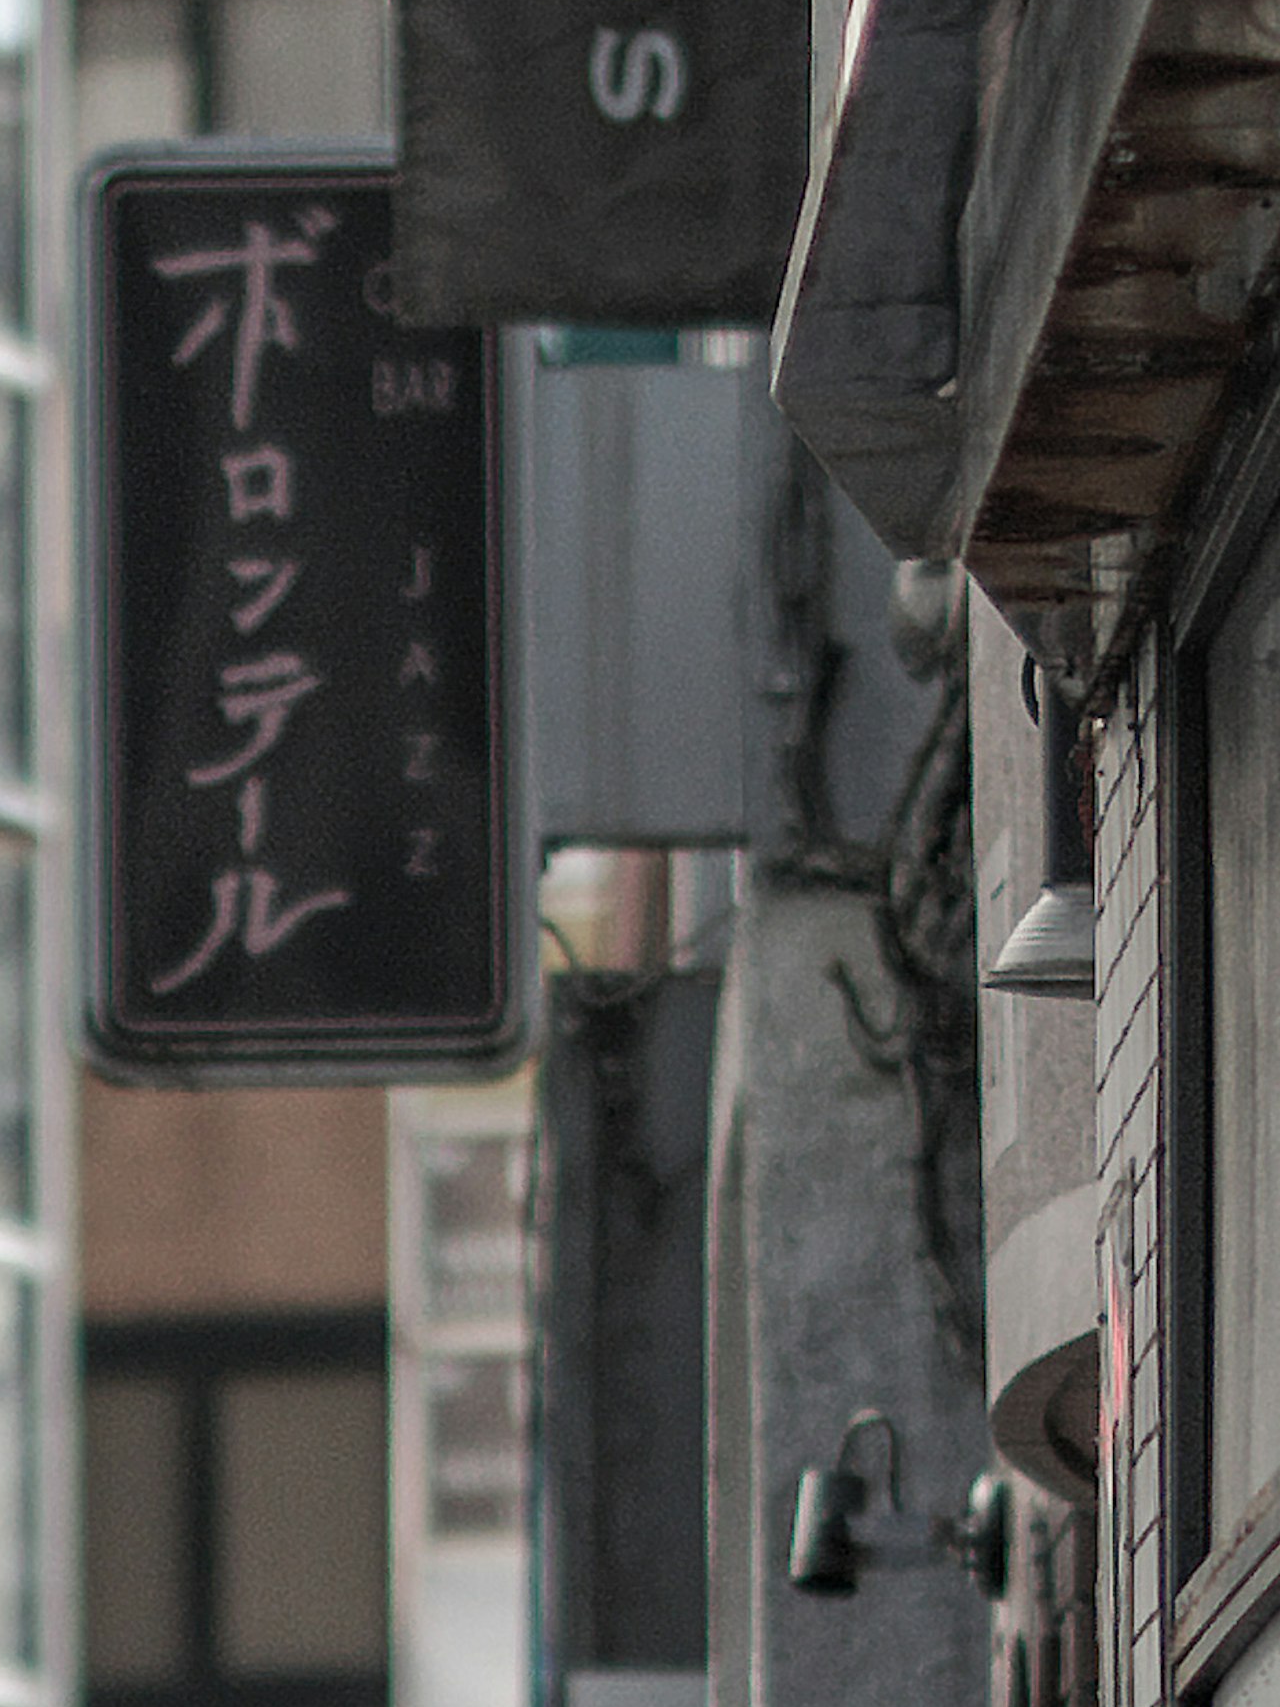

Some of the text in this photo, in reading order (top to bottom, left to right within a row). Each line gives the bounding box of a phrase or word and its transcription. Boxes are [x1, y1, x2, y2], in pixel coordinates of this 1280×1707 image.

[370, 359, 456, 416] BAR
[152, 206, 352, 995] ボロンテール
[400, 545, 441, 878] JAZZ
